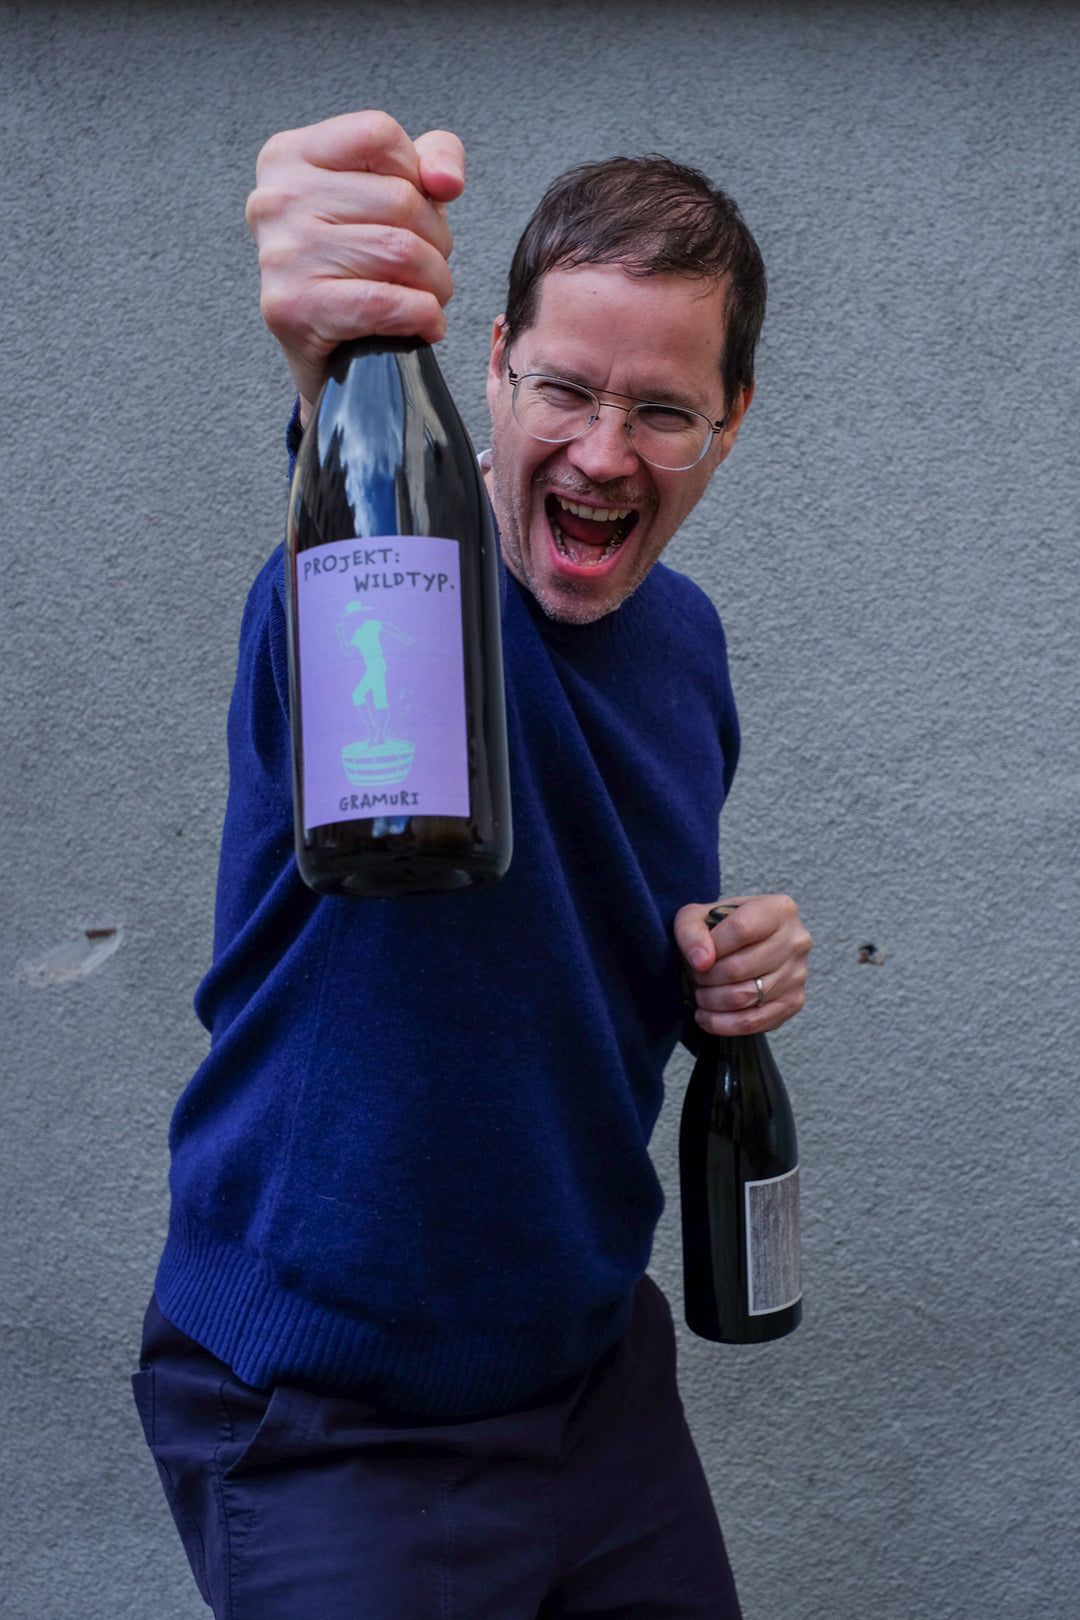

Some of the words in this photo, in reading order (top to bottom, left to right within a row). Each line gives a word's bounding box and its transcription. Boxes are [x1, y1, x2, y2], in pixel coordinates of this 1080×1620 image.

[304, 548, 400, 582] PROJEKT:
[354, 571, 455, 593] WILDTYP.
[339, 790, 419, 812] GRAMURI
